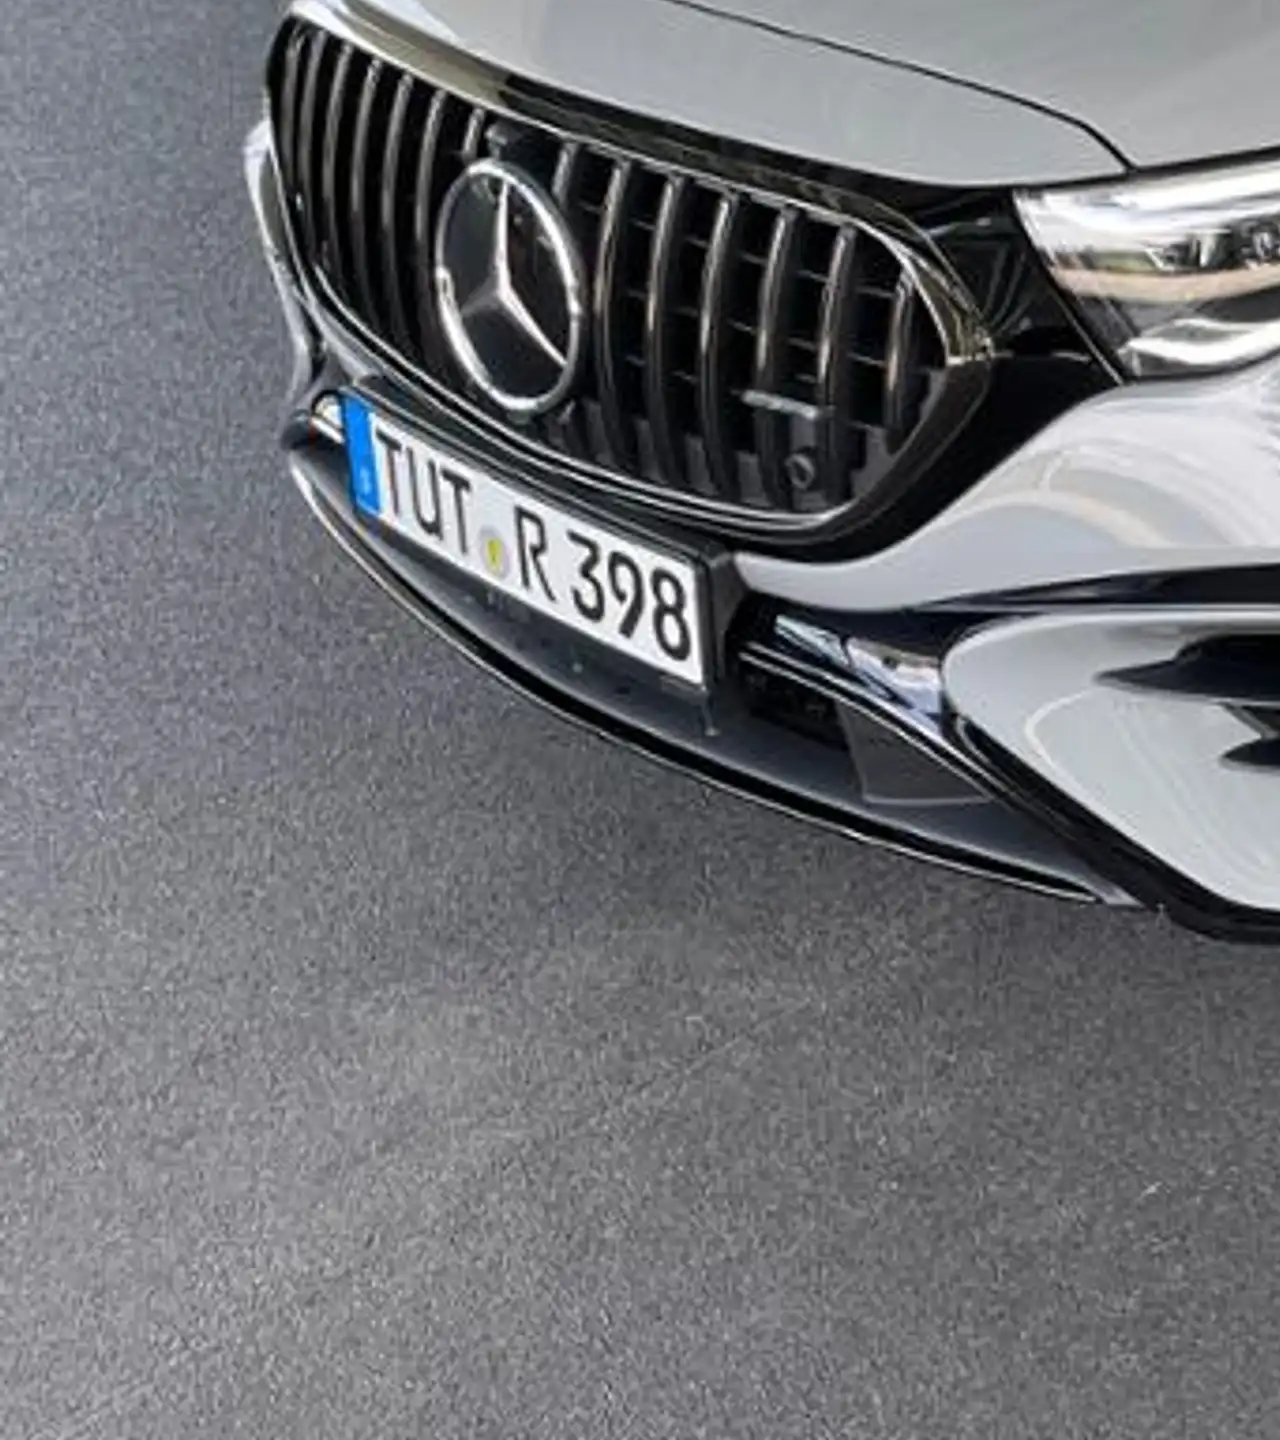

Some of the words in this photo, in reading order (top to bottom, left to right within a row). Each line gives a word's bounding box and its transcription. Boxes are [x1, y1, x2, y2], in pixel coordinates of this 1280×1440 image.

[375, 430, 471, 556] TUT
[514, 506, 557, 603] R
[567, 529, 692, 661] 398
